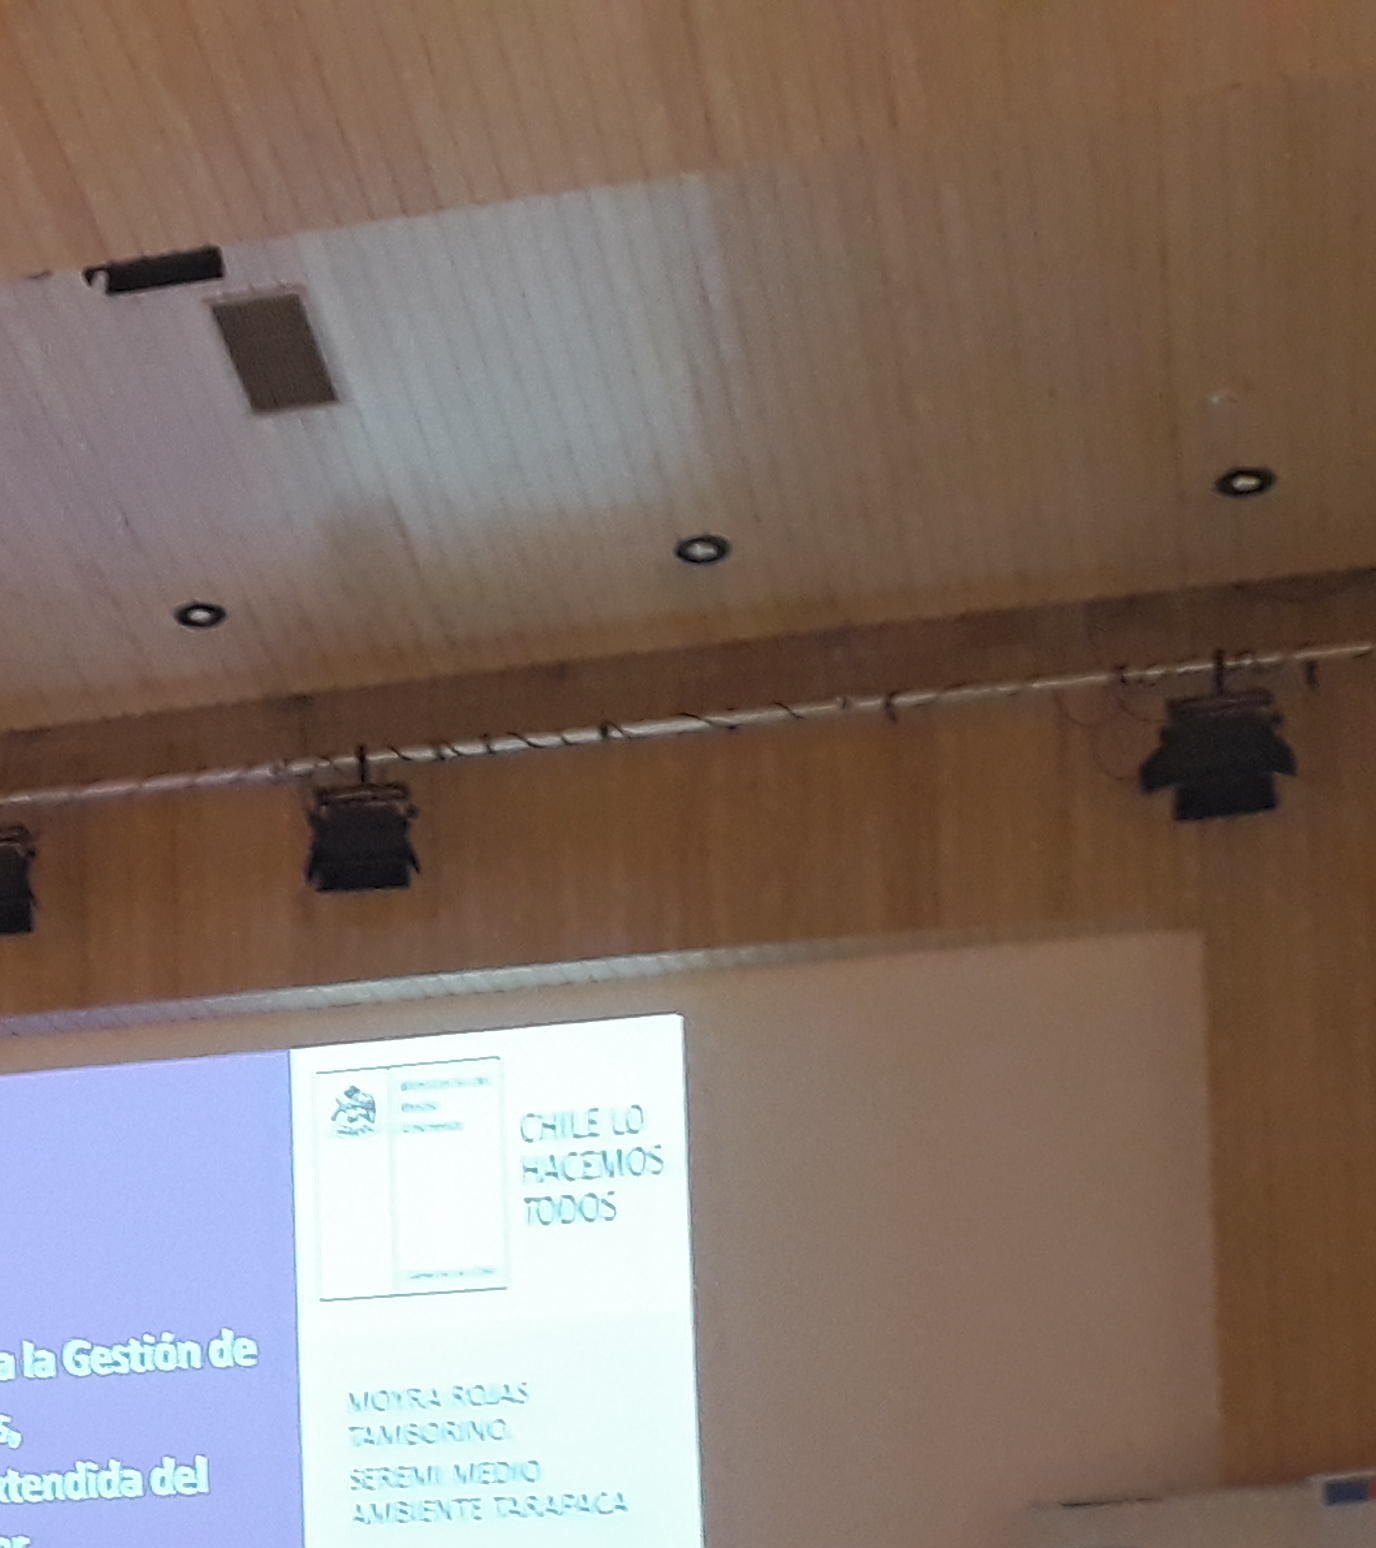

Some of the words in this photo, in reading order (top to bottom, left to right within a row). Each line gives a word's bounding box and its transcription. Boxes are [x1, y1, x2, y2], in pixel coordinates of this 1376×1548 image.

[520, 1107, 601, 1143] CHILE
[611, 1104, 644, 1136] LO
[522, 1145, 664, 1184] HACEMOS
[523, 1191, 617, 1226] TODOS
[23, 1340, 56, 1379] la
[63, 1331, 202, 1377] Gestión
[209, 1328, 259, 1368] de
[451, 1382, 529, 1407] ROJAS
[150, 1455, 209, 1495] del
[350, 1465, 441, 1491] SEREMI
[453, 1459, 541, 1485] MEDIO
[352, 1498, 484, 1525] AMBIENTE
